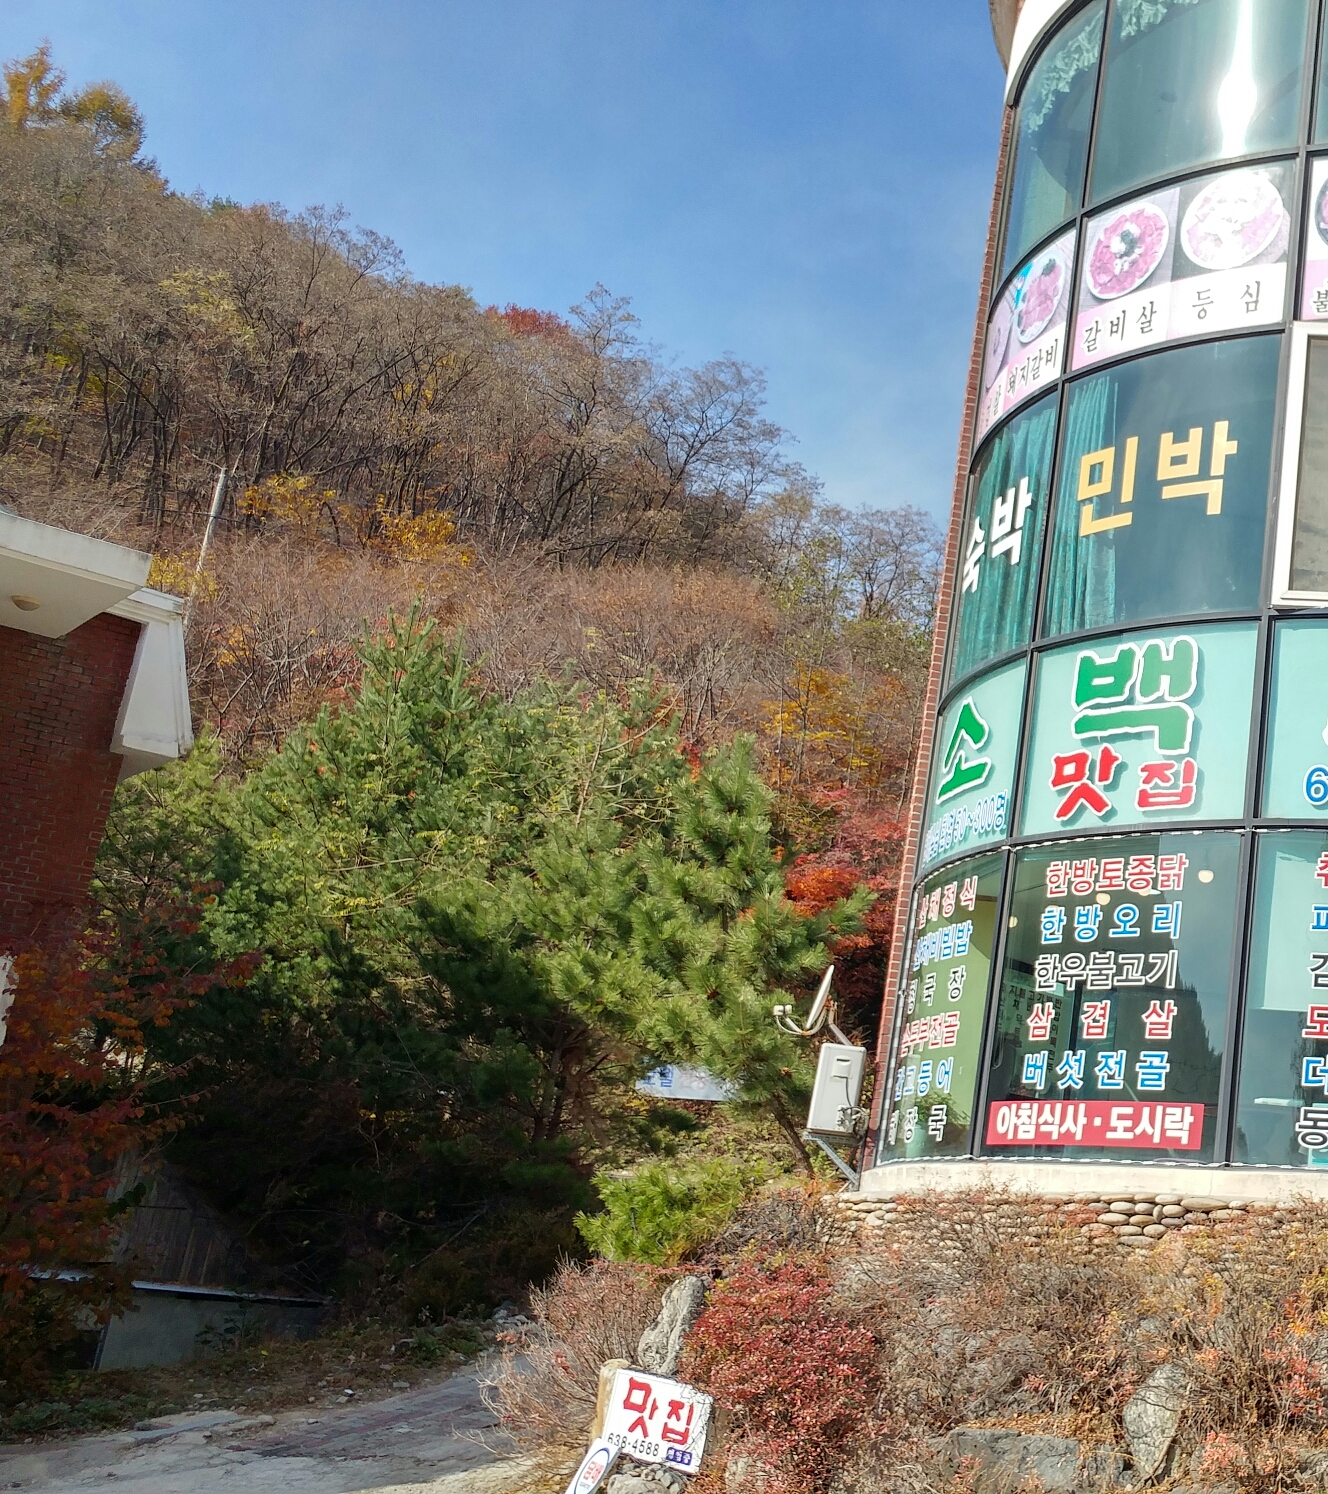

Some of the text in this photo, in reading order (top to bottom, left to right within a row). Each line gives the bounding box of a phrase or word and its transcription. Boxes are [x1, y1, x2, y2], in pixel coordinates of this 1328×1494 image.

[1084, 300, 1158, 354] 갈비살
[963, 420, 1238, 593] 숙박 민박
[1050, 744, 1198, 821] 맛집
[1046, 853, 1190, 898] 한방토종닭
[919, 876, 978, 930] 산채정식
[1040, 901, 1183, 944] 한방오리
[1034, 950, 1179, 991] 한우불고기
[1022, 1050, 1171, 1092] 버섯전골
[623, 1376, 695, 1446] 맛집
